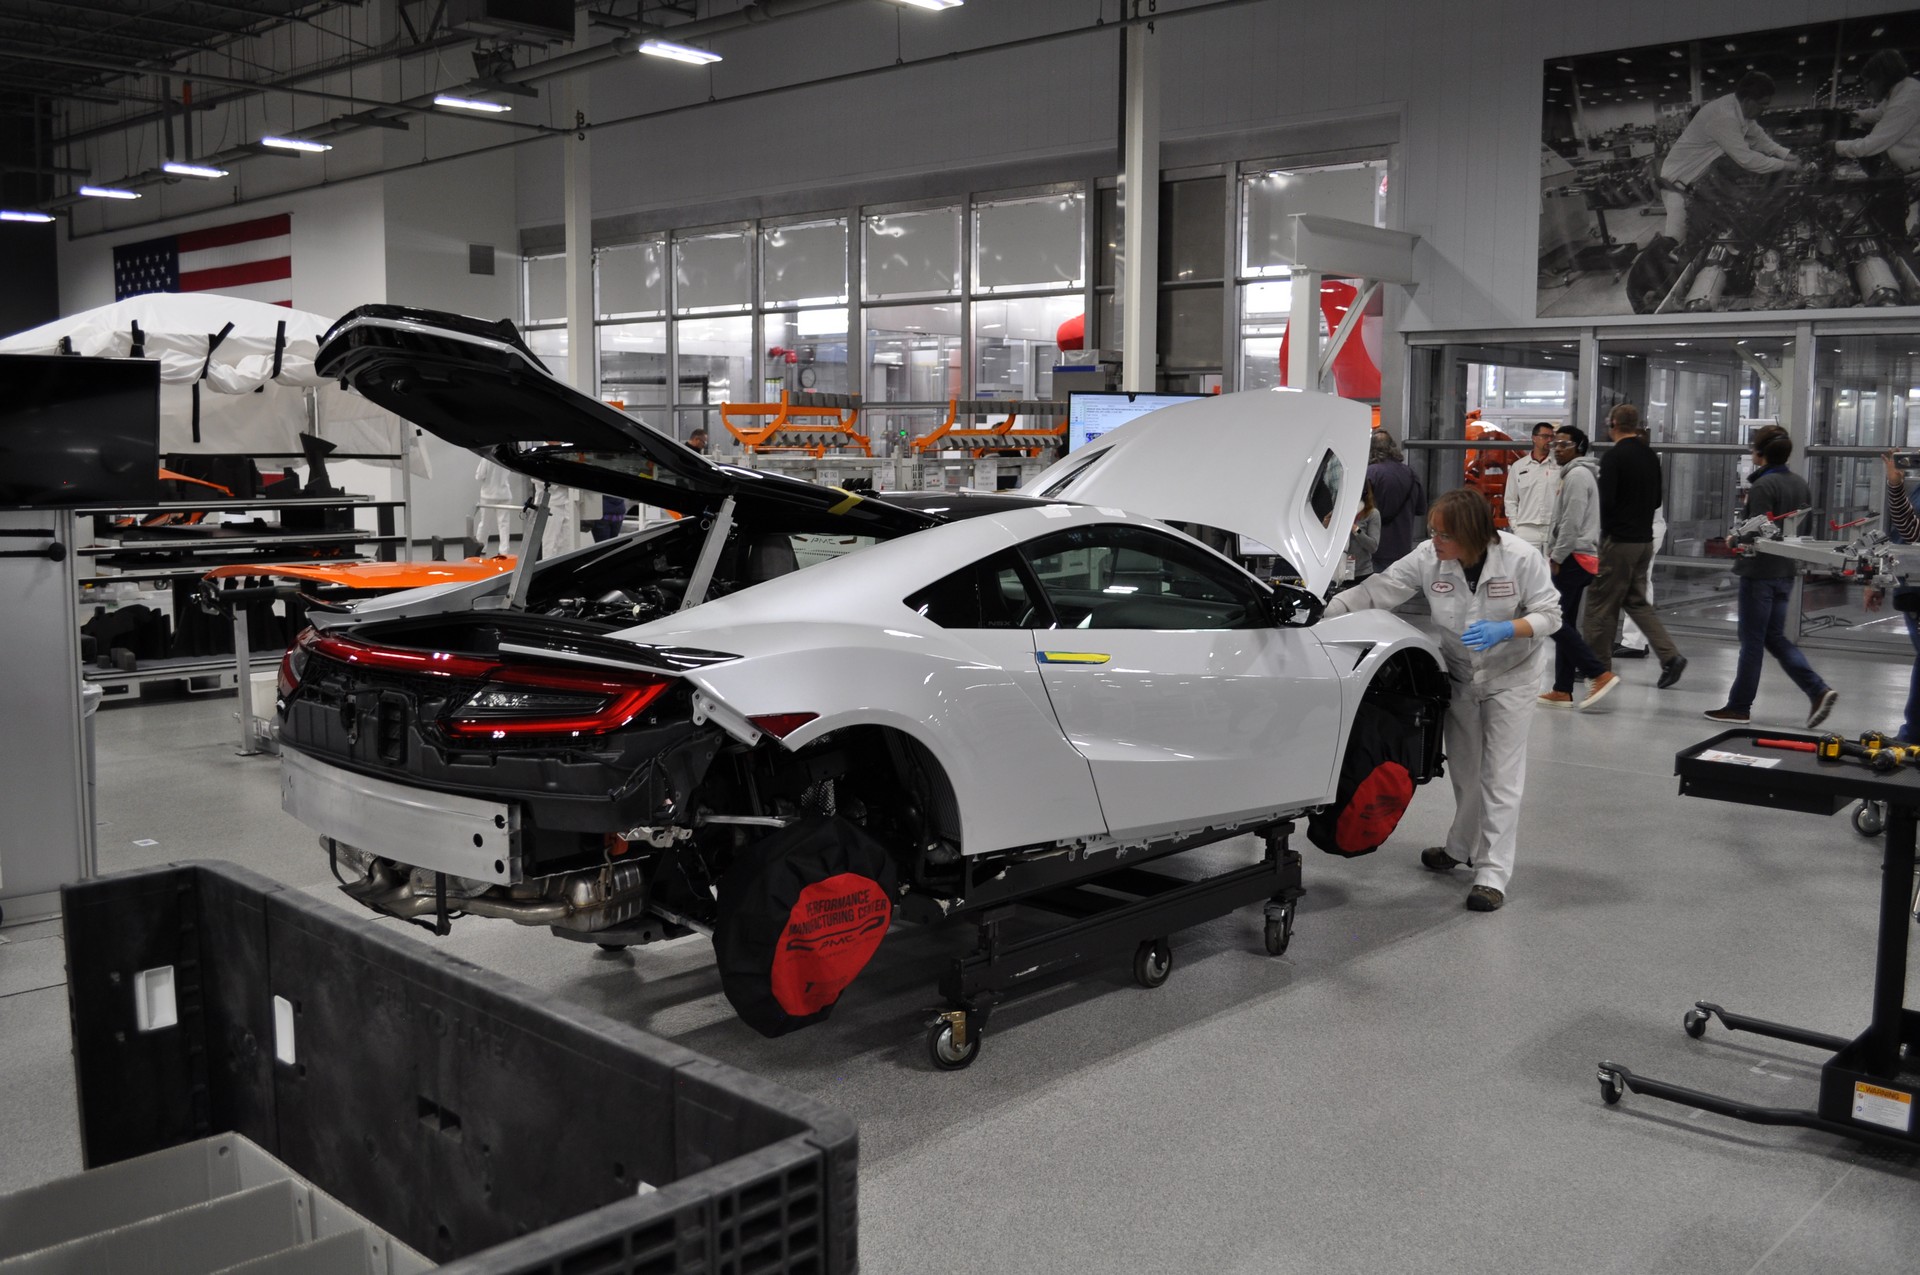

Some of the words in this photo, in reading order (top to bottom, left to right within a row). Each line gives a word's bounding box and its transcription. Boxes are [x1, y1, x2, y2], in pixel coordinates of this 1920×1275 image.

[788, 908, 855, 936] MANUFACTURING
[857, 898, 887, 919] CENTER
[805, 889, 870, 917] PERFORMANCE
[819, 935, 857, 950] PMC
[419, 1002, 448, 1037] TO
[1865, 1084, 1900, 1101] WARNING
